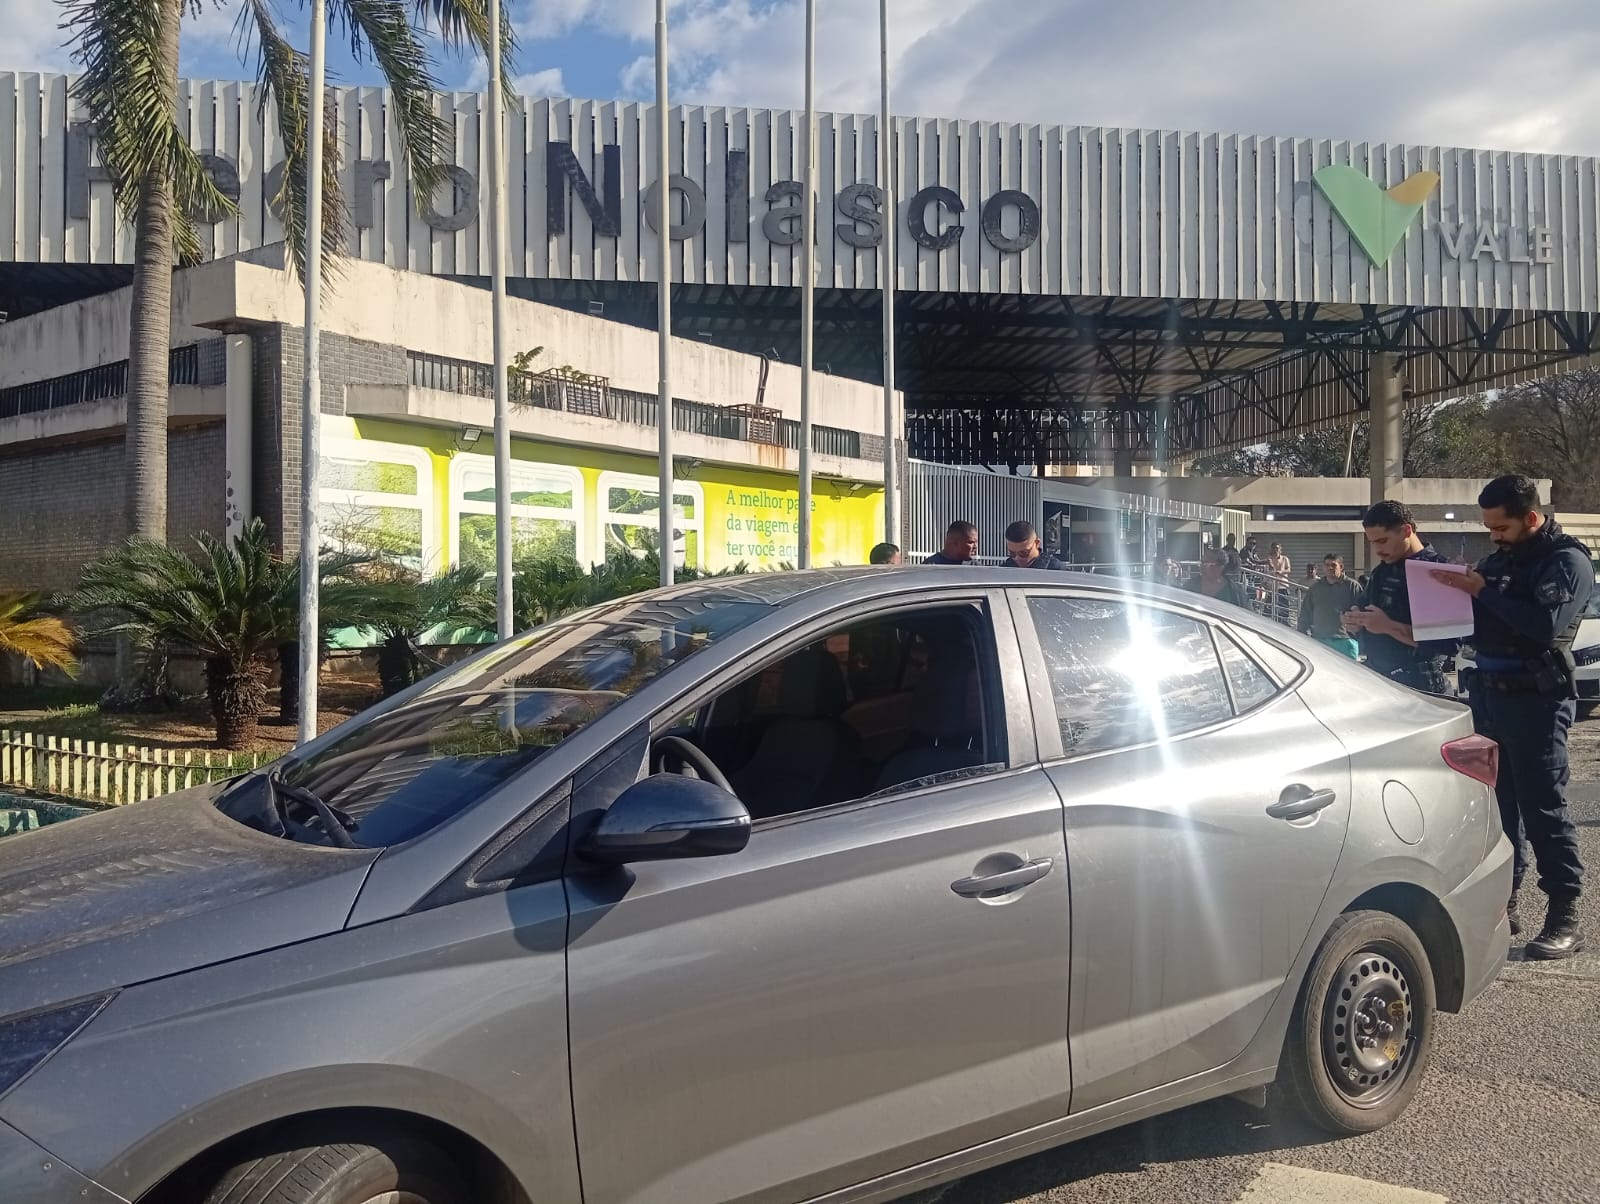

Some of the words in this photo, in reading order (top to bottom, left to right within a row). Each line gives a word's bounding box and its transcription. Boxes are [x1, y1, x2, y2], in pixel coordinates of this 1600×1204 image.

[66, 121, 478, 232] Pero
[547, 141, 1040, 253] Nolasco
[1437, 221, 1554, 265] VALE
[726, 490, 737, 505] A
[739, 491, 785, 509] melhor
[786, 497, 816, 514] pae
[726, 513, 742, 531] da
[746, 516, 789, 537] viagem
[726, 541, 744, 556] ter
[748, 540, 776, 557] você
